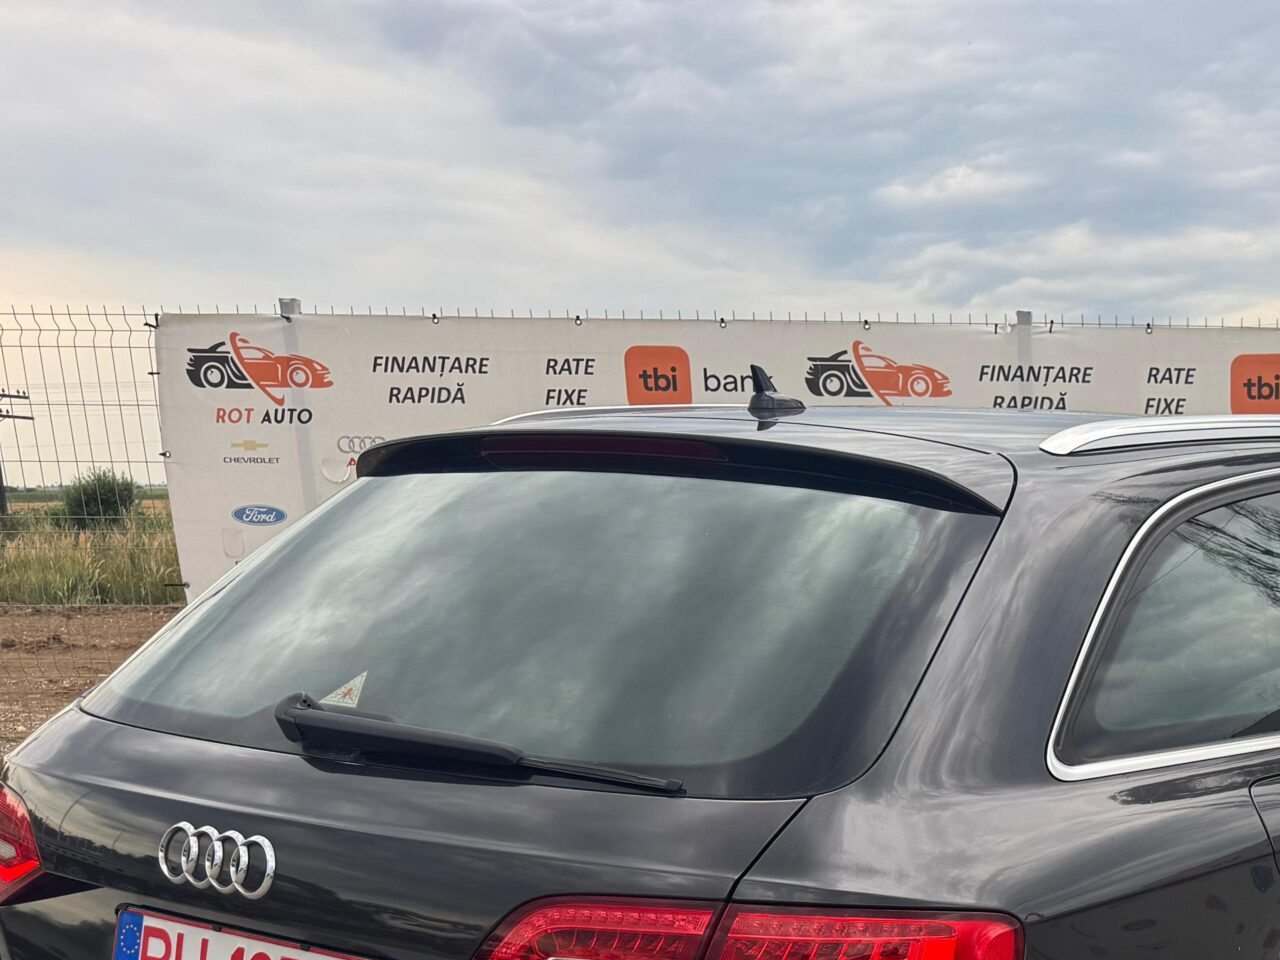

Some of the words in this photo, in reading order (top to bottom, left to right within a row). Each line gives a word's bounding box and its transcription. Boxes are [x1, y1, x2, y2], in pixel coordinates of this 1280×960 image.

[372, 355, 489, 377] FINANȚARE
[545, 358, 596, 376] RATE
[979, 364, 1093, 386] FINANȚARE
[639, 366, 678, 392] tbi
[703, 368, 773, 392] ban
[1148, 367, 1196, 384] RATE
[388, 382, 465, 404] RAPIDĂ
[1244, 375, 1280, 400] tbi
[545, 389, 587, 406] FIXE
[1145, 397, 1187, 415] FIXE
[216, 408, 254, 424] ROT
[261, 408, 313, 424] AUTO
[242, 507, 276, 523] Ford
